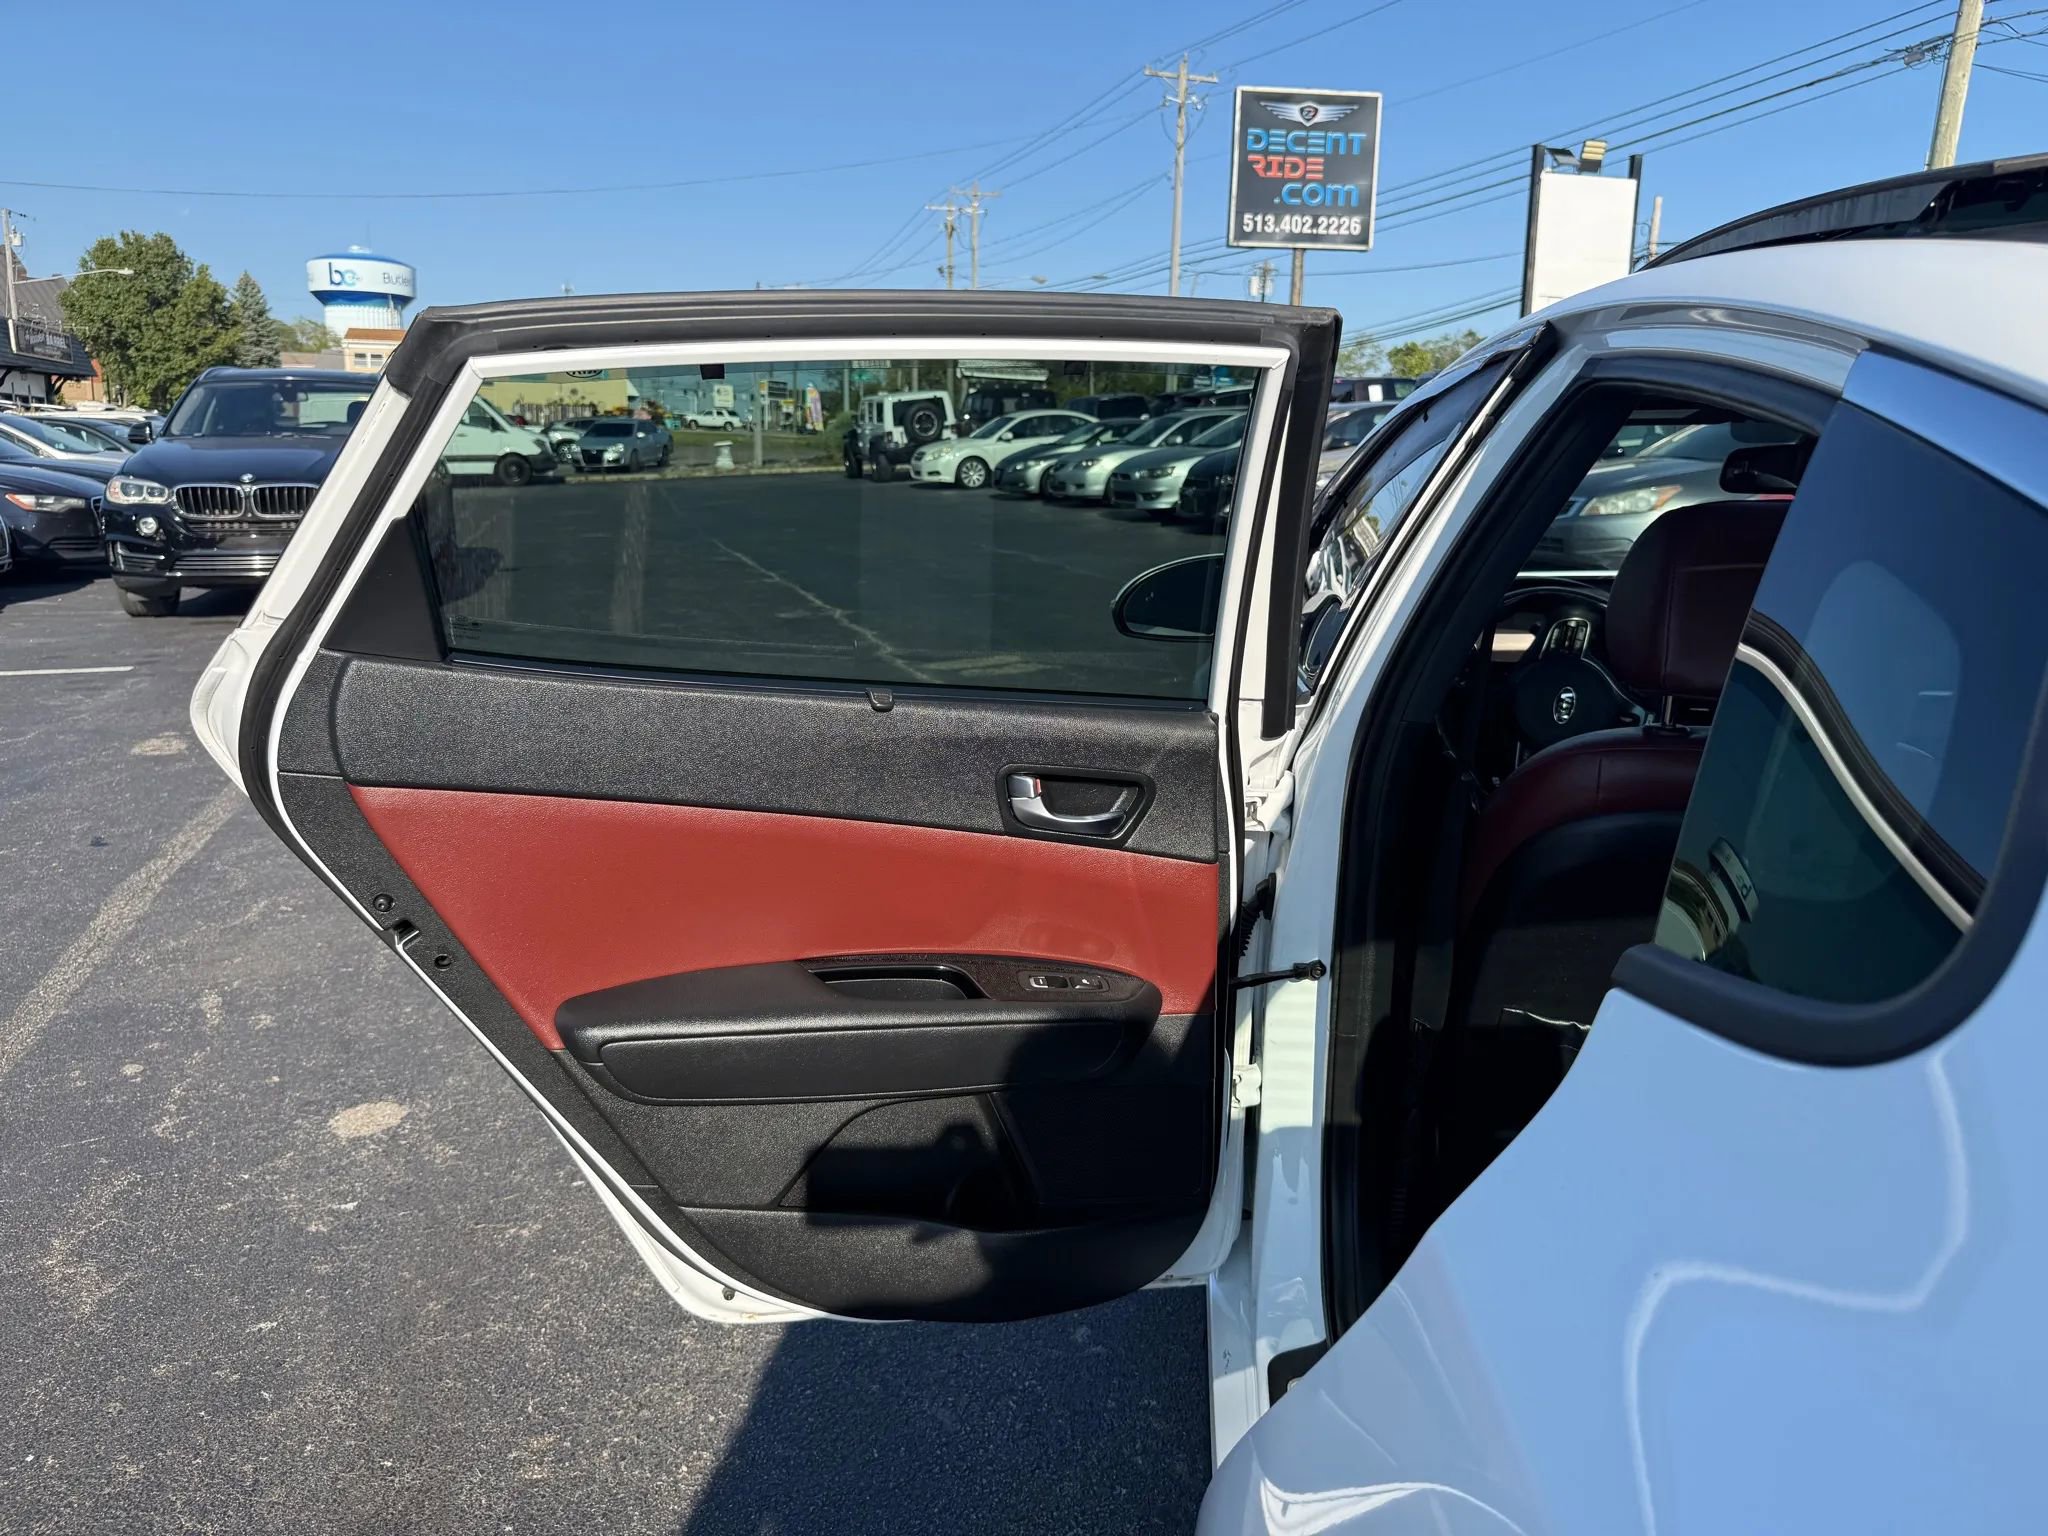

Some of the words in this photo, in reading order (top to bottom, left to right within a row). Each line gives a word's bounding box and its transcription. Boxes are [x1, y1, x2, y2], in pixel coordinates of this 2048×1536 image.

[1247, 128, 1367, 155] DECENT
[1247, 154, 1325, 179] RIDE
[1243, 213, 1362, 235] 513.402.2226
